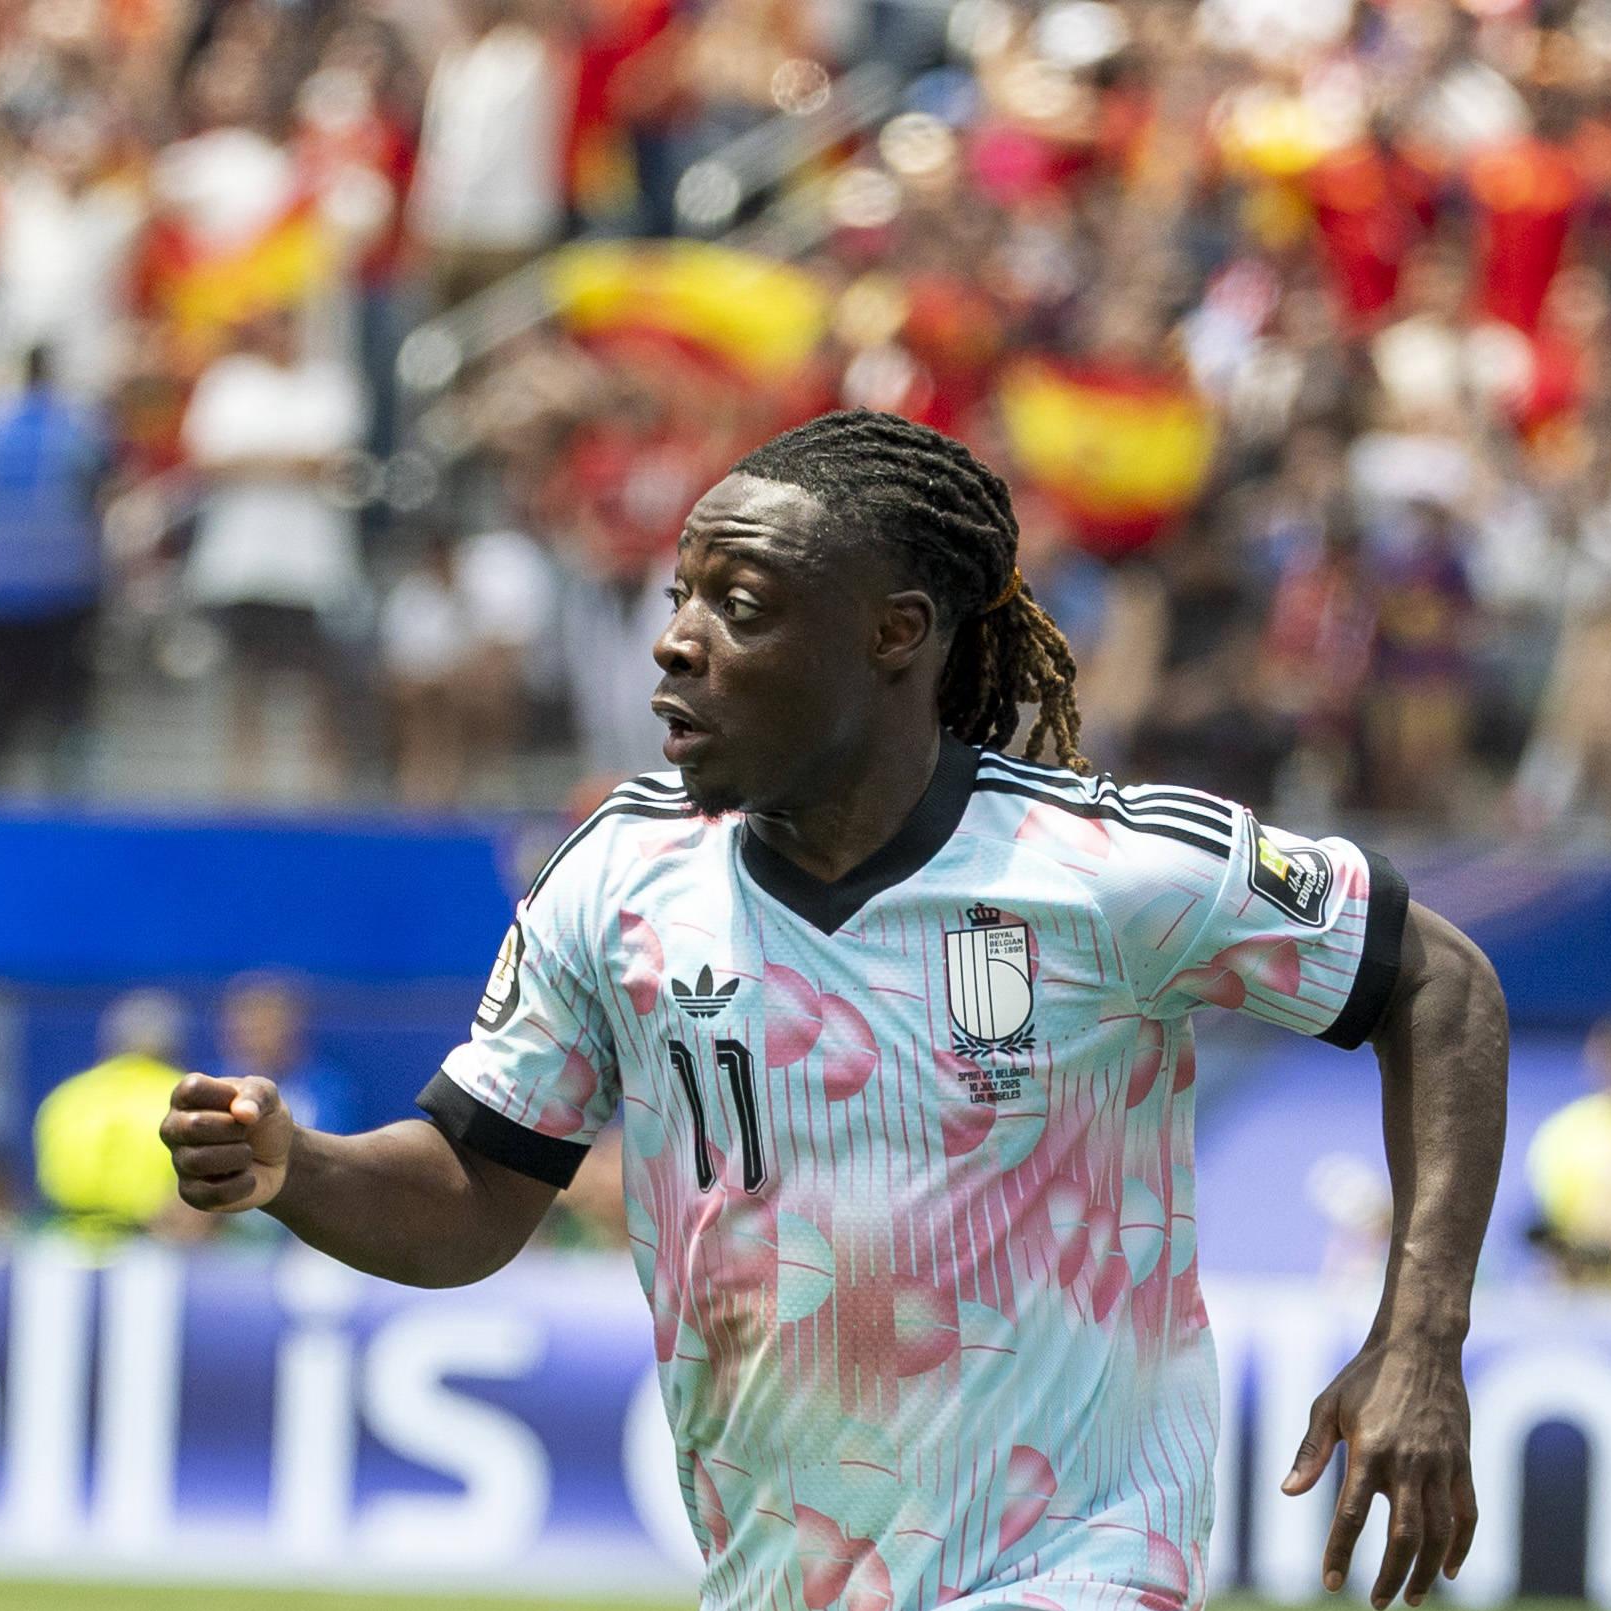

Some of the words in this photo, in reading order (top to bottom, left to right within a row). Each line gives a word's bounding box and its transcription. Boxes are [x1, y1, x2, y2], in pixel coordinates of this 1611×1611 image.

[989, 931, 1013, 940] ROYAL
[989, 938, 1023, 947] BELGIAN
[969, 1083, 978, 1092] 10
[980, 1081, 998, 1091] JULY
[1000, 1079, 1021, 1090] 2026
[970, 1093, 986, 1104] LOS
[987, 1090, 1021, 1102] ANGELES
[668, 1039, 768, 1194] 11
[272, 1242, 551, 1566] is
